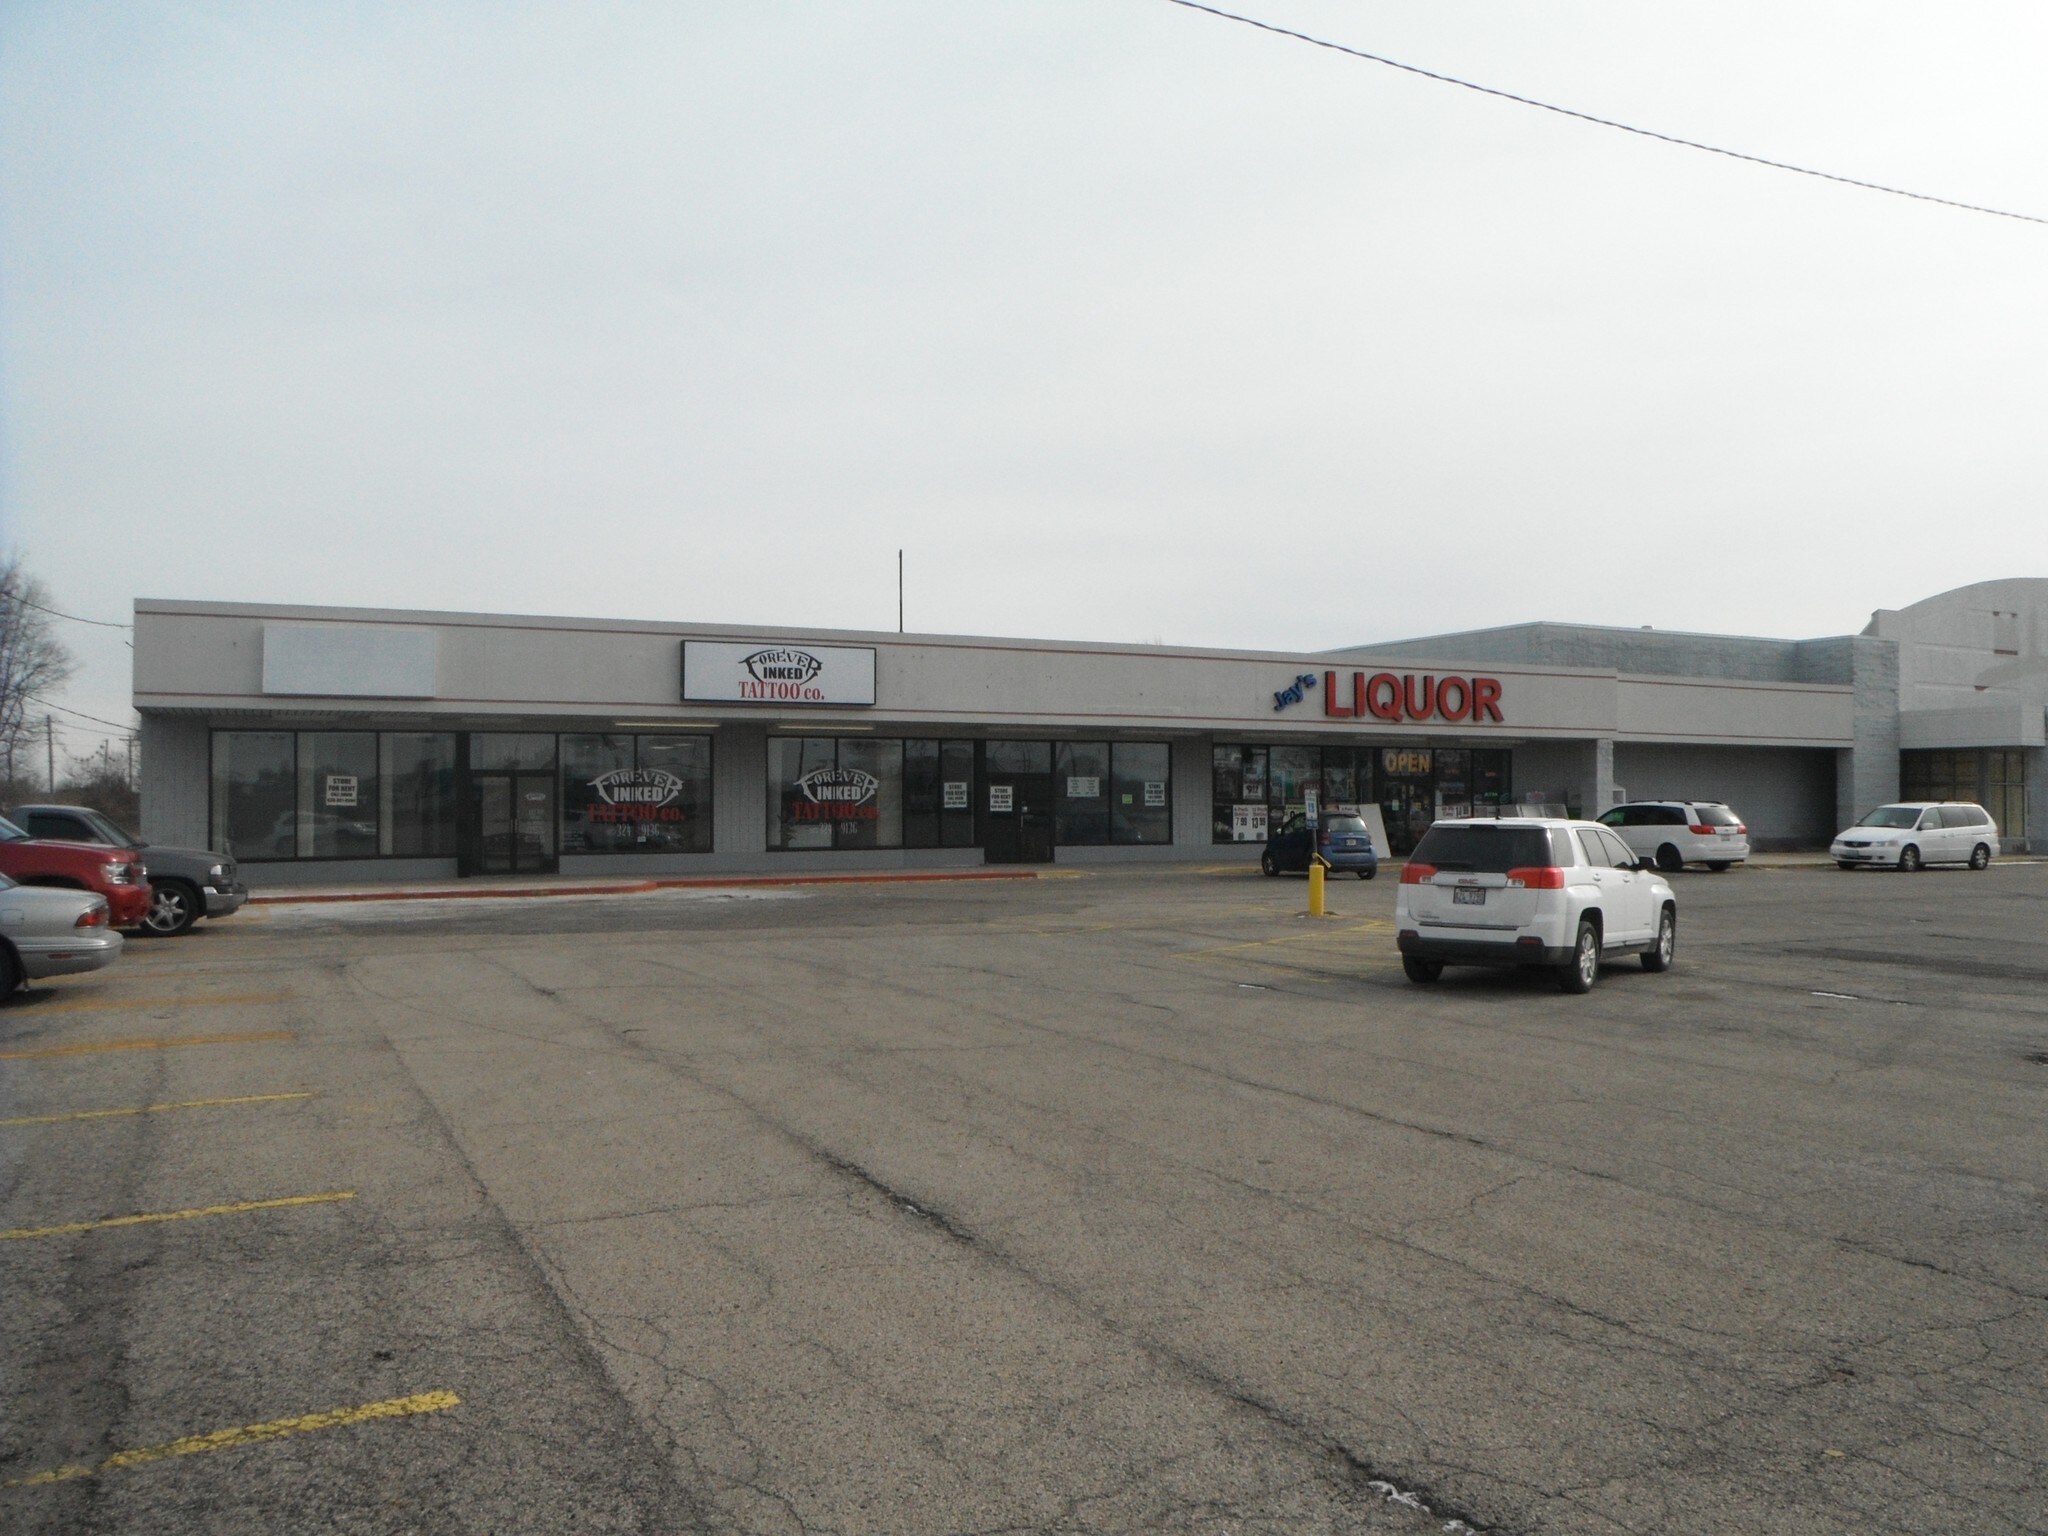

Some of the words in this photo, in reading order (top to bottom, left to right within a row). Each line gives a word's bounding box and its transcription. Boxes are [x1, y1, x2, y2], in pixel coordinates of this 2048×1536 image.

[738, 648, 823, 685] FOREVER
[763, 667, 803, 680] INKED
[739, 681, 801, 699] TATTOO
[1273, 673, 1317, 712] Jay's
[1324, 671, 1505, 722] LIQUOR
[1385, 752, 1431, 773] OPEN
[587, 767, 685, 807] FOREVER
[613, 786, 663, 802] INKED
[793, 767, 880, 806] FOREVER
[817, 786, 861, 800] INKED
[587, 803, 657, 822] TATTOO
[793, 801, 855, 821] TATTOO
